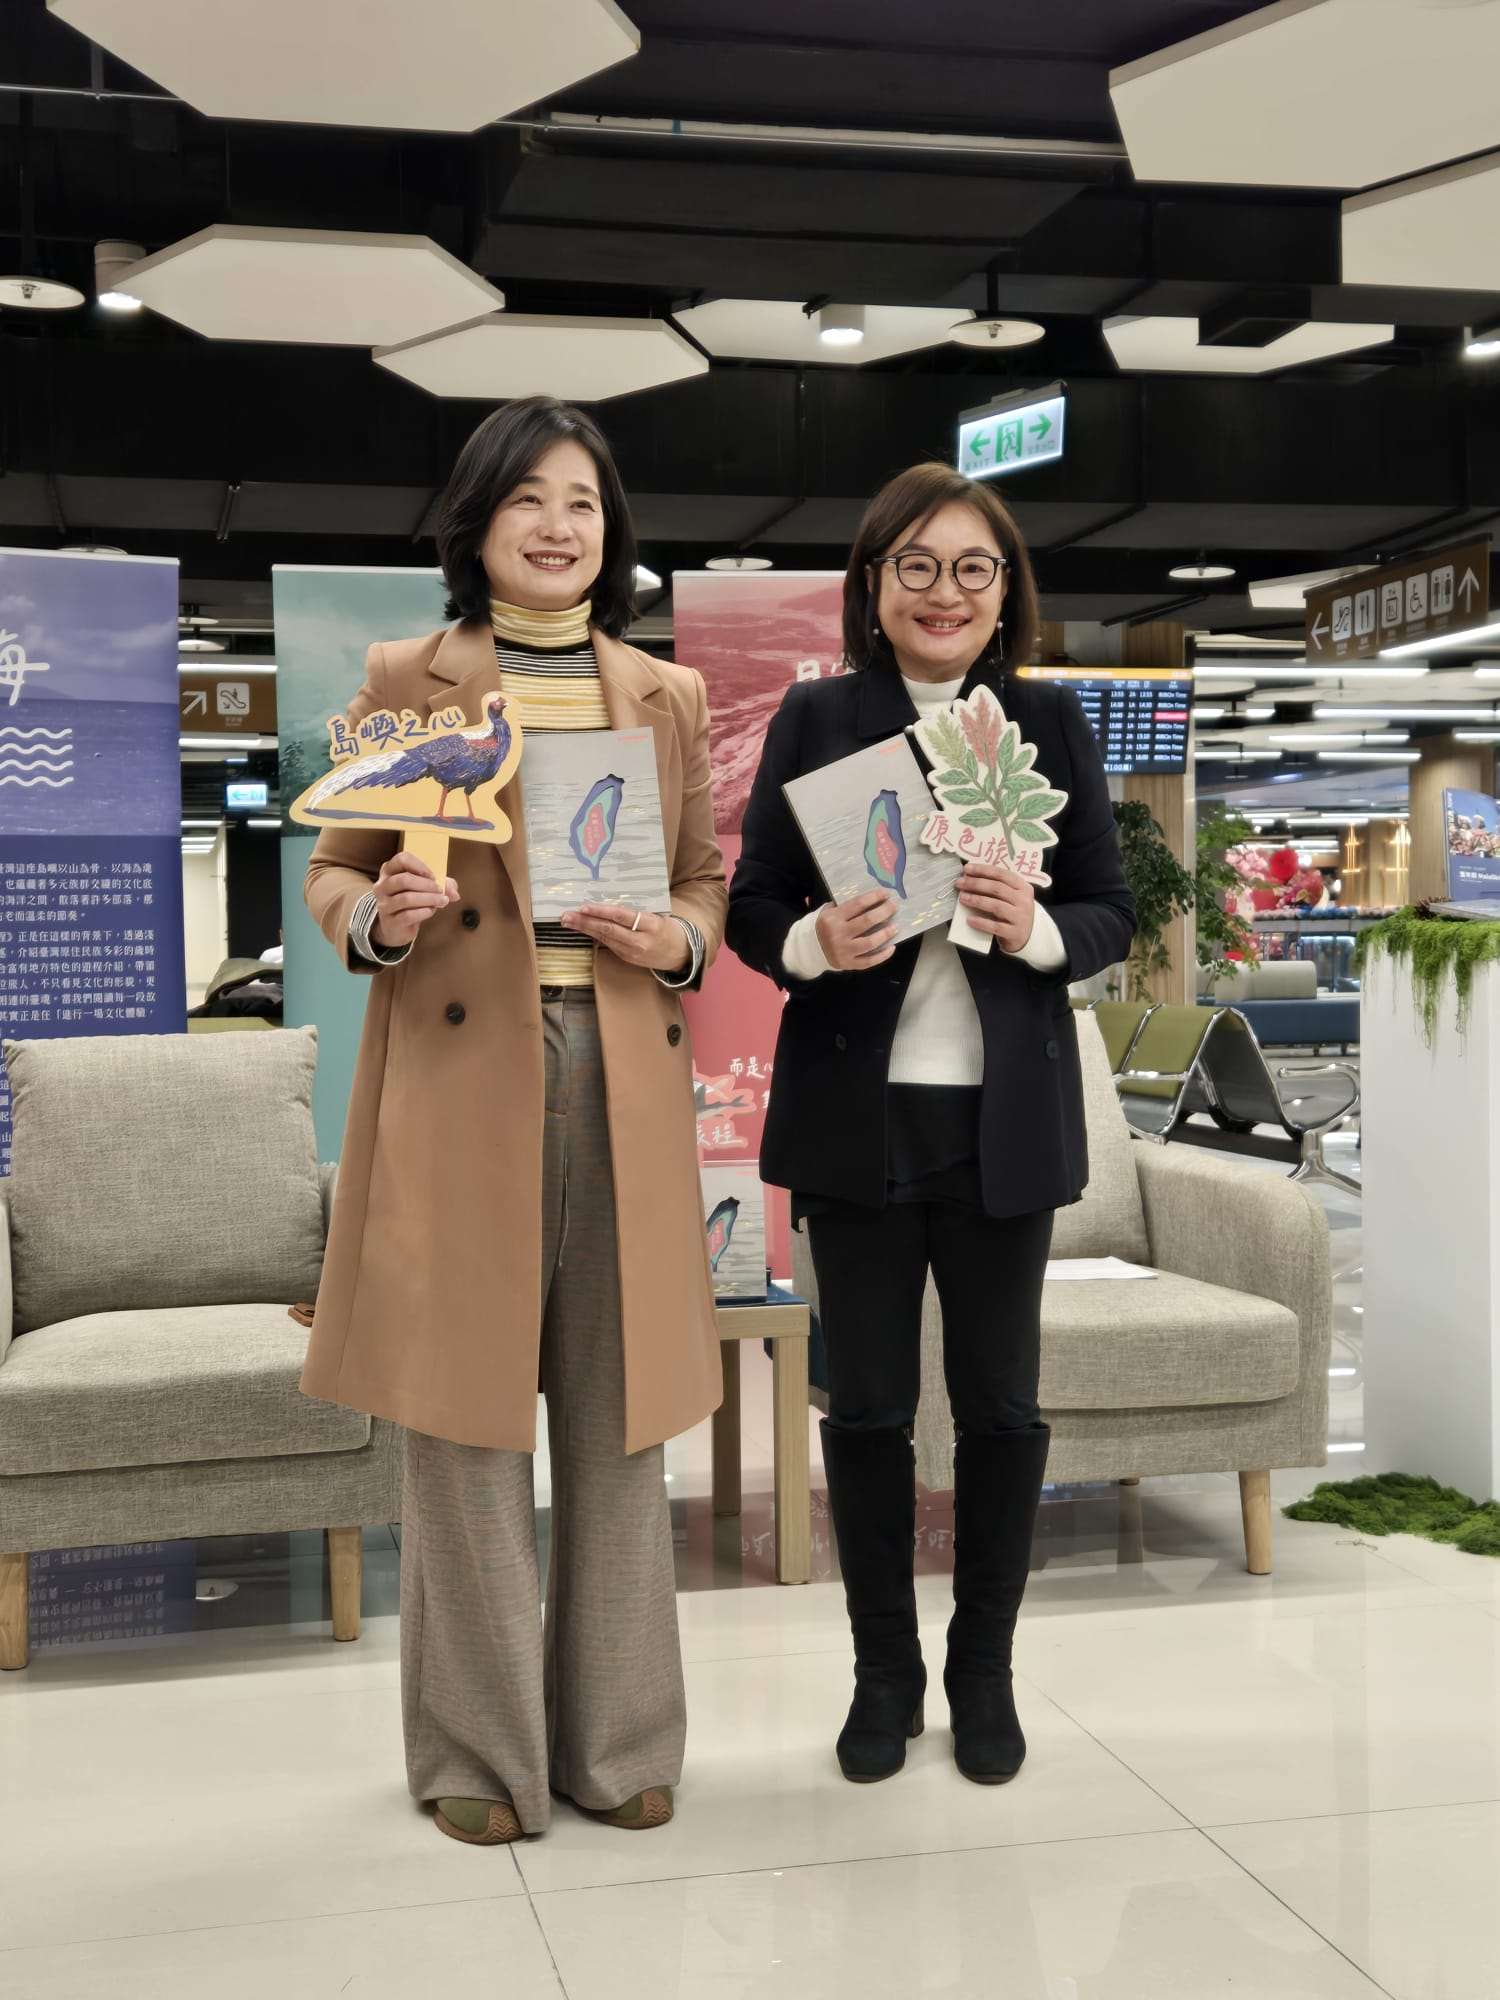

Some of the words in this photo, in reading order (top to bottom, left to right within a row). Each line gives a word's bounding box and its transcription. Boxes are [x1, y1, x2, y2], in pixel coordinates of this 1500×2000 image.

[331, 710, 461, 755] 島嶼之心
[926, 815, 1047, 881] 原色旅程
